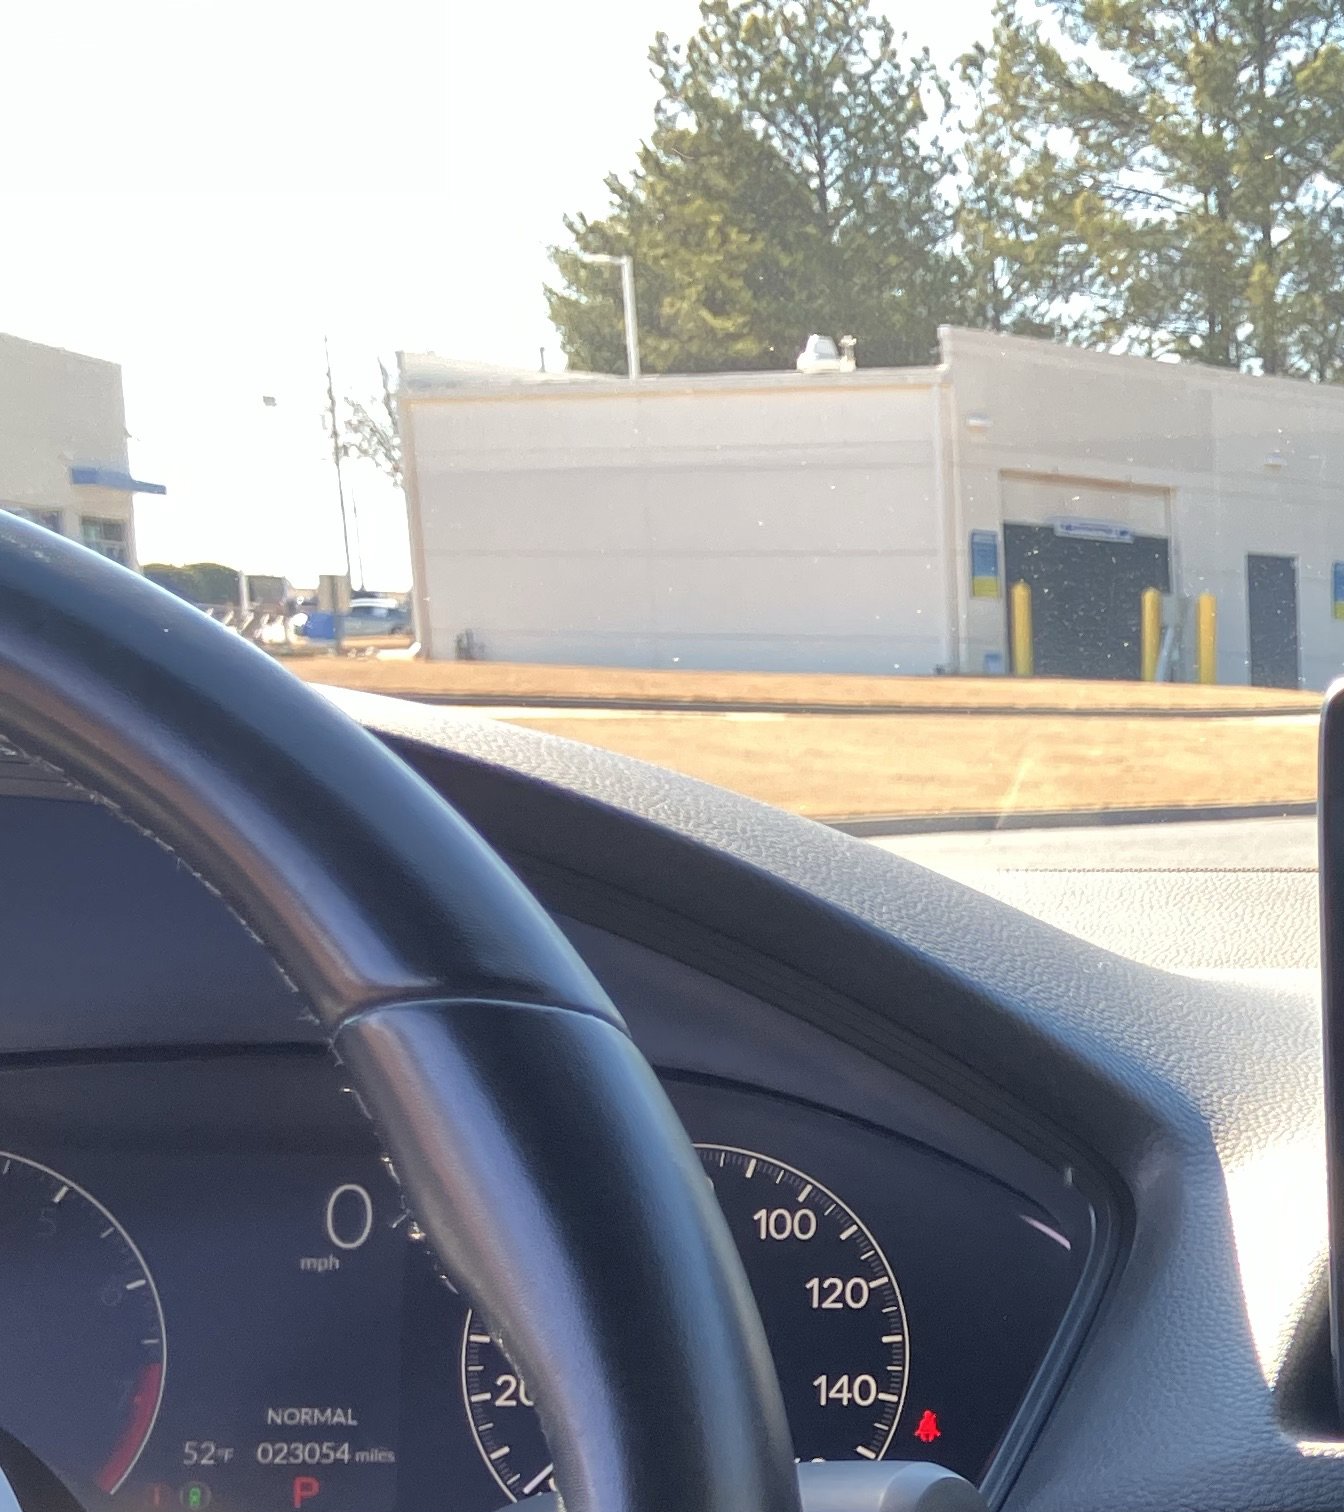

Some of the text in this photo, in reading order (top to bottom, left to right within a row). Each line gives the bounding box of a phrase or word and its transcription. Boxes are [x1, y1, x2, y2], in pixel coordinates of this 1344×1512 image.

[327, 1183, 372, 1249] 0
[753, 1208, 817, 1240] 100
[300, 1254, 340, 1272] mph
[805, 1277, 869, 1309] 120
[812, 1374, 877, 1407] 140
[267, 1407, 358, 1426] NORMAL
[256, 1442, 395, 1465] 023054 miles
[293, 1476, 320, 1509] P
